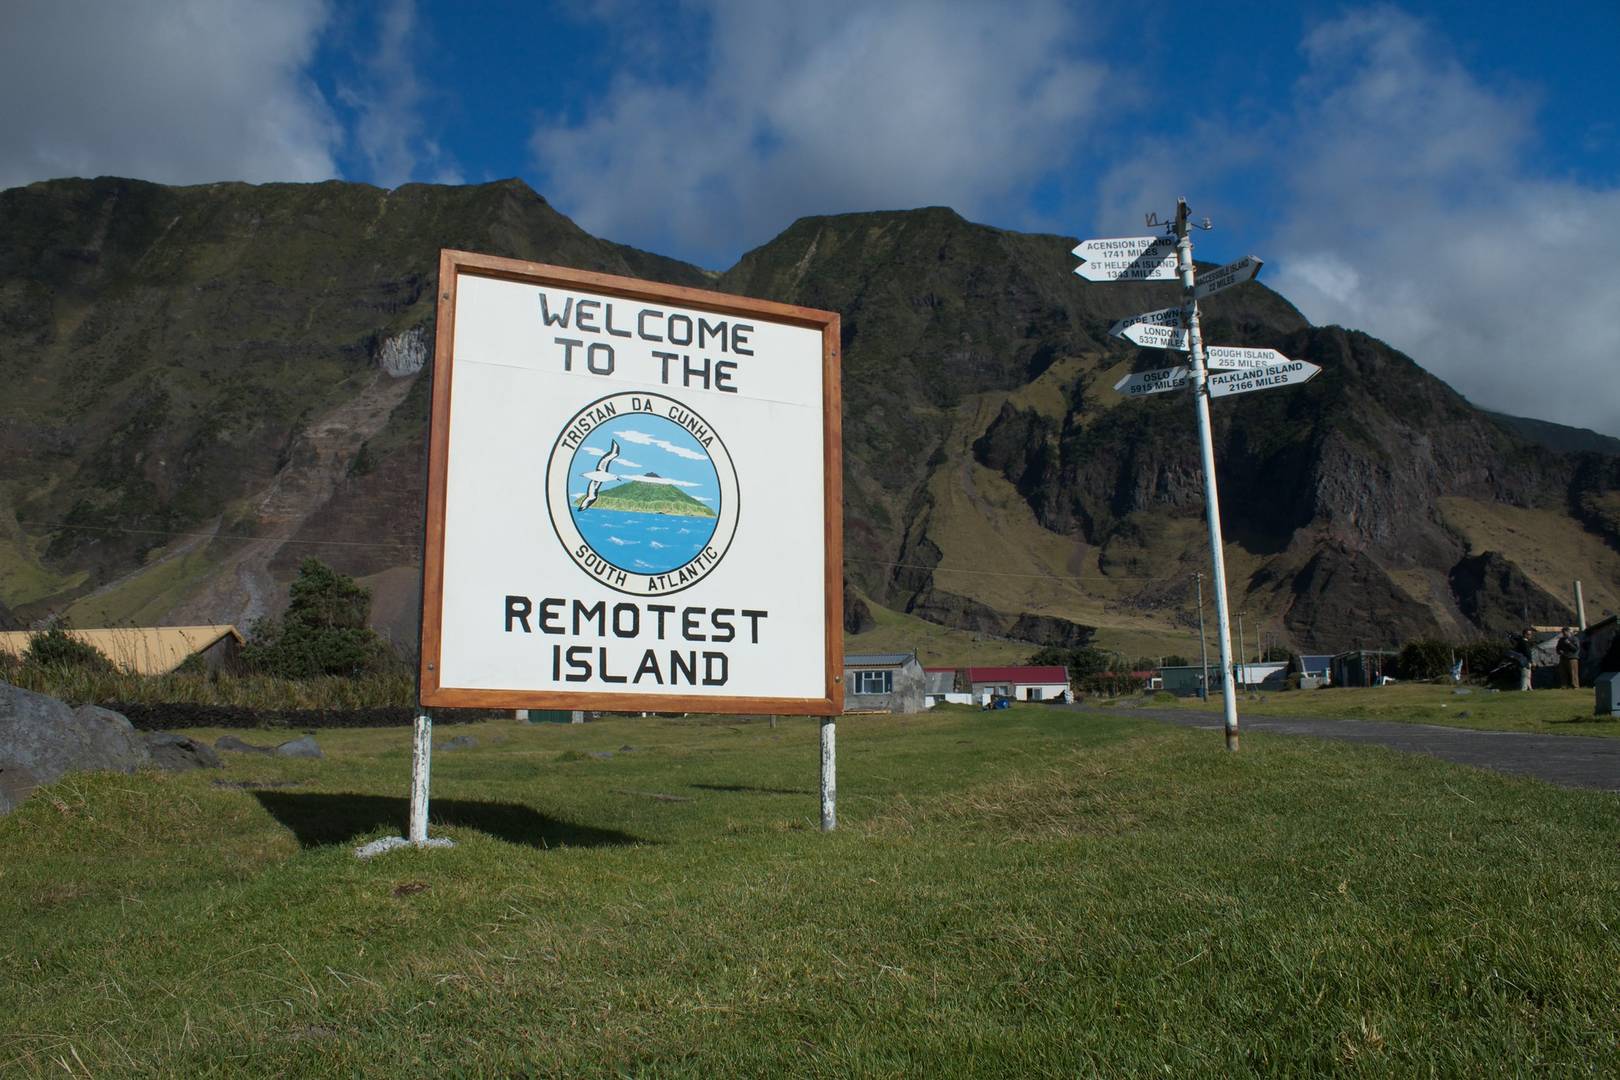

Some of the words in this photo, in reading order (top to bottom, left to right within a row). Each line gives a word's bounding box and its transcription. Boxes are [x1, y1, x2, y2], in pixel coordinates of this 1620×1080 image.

[1087, 241, 1135, 250] ACENSION
[1138, 239, 1172, 248] ISLAND
[1103, 250, 1124, 258] 1741
[1127, 248, 1158, 257] MILES
[1090, 262, 1102, 270] ST
[1104, 261, 1140, 270] HELENA
[1142, 260, 1175, 269] ISLAND
[1131, 269, 1162, 278] MILES
[538, 292, 755, 357] WELCOME
[1122, 316, 1148, 328] CAPE
[1150, 309, 1179, 322] TOWN
[1144, 327, 1179, 338] LONDON
[1139, 336, 1157, 345] 5337
[1160, 338, 1186, 348] MILES
[1210, 348, 1241, 358] GOUGH
[1244, 350, 1274, 360] ISLAND
[553, 337, 615, 376] TO
[652, 351, 739, 394] THE
[1218, 359, 1235, 367] 255
[1238, 360, 1267, 368] MILES
[1143, 370, 1170, 382] OSLO
[1212, 370, 1263, 385] FALKLAND
[1266, 362, 1303, 375] ISLAND
[1130, 383, 1153, 394] 5915
[1154, 378, 1185, 390] MILES
[1229, 381, 1253, 392] 2166
[1255, 374, 1288, 387] MILES
[561, 401, 617, 451] TRISTAN
[632, 397, 653, 412] DA
[668, 406, 714, 449] CUNHA
[575, 544, 628, 587] SOUTH
[648, 546, 718, 591] ATLANTIC
[504, 595, 769, 644] REMOTEST
[551, 644, 729, 687] ISLAND
